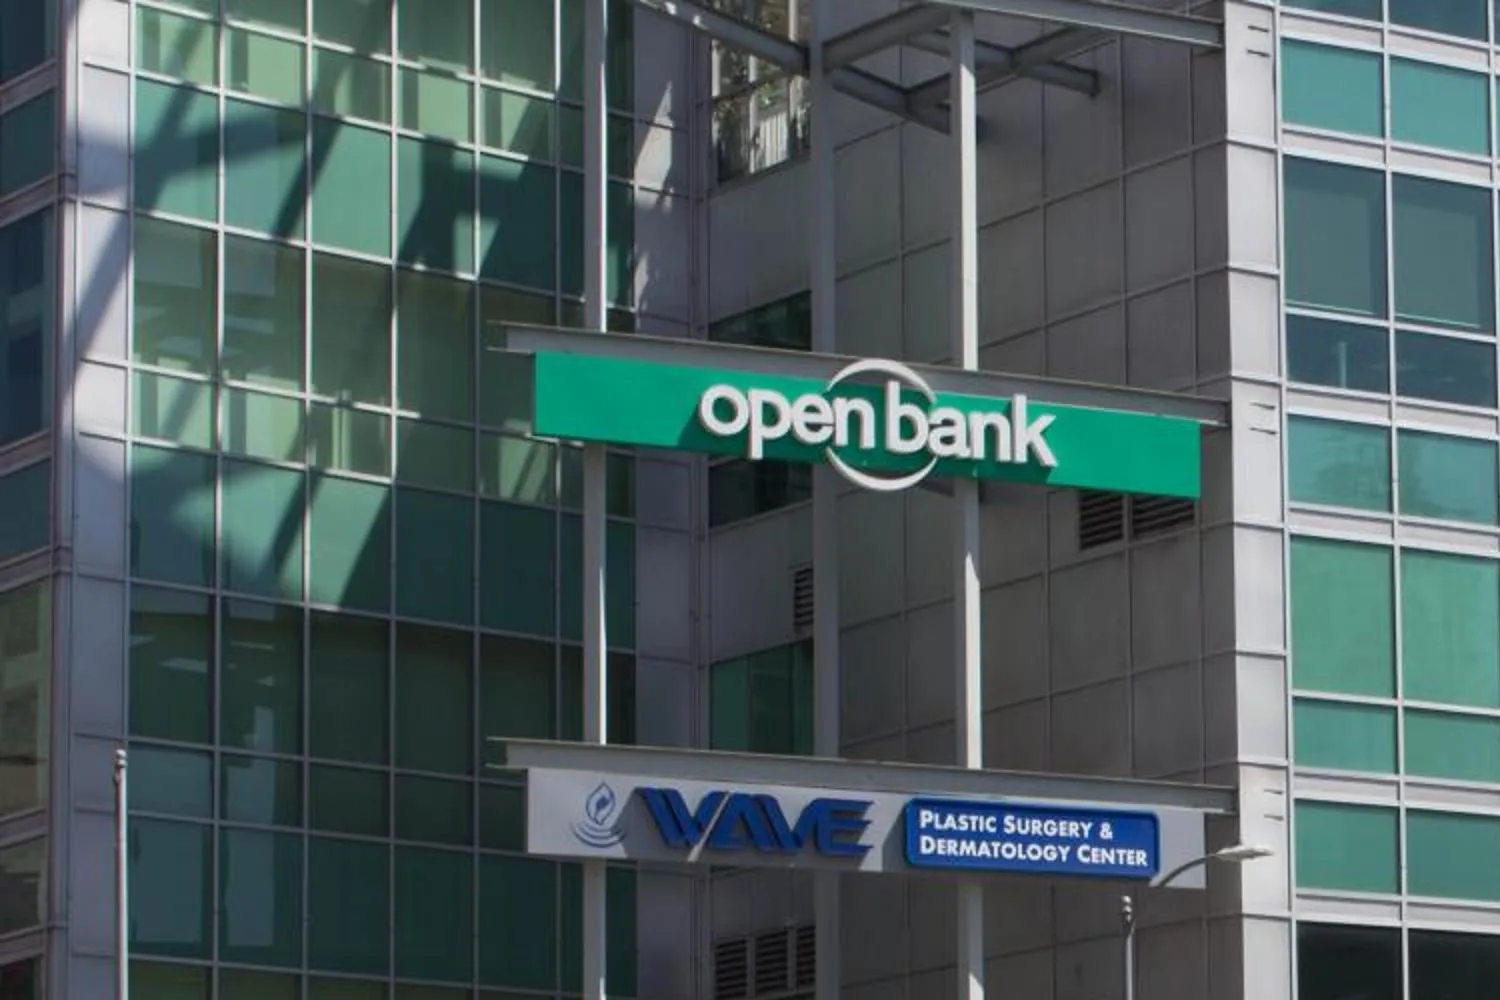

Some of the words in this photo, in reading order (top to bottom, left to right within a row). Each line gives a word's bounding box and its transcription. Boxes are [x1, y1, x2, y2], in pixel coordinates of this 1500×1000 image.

[637, 787, 875, 858] WAVE
[919, 808, 997, 833] PLASTIC
[1003, 814, 1093, 839] SURGERY
[1099, 821, 1114, 840] &
[919, 835, 1071, 863] DERMATOLOGY
[1076, 843, 1149, 867] CENTER
